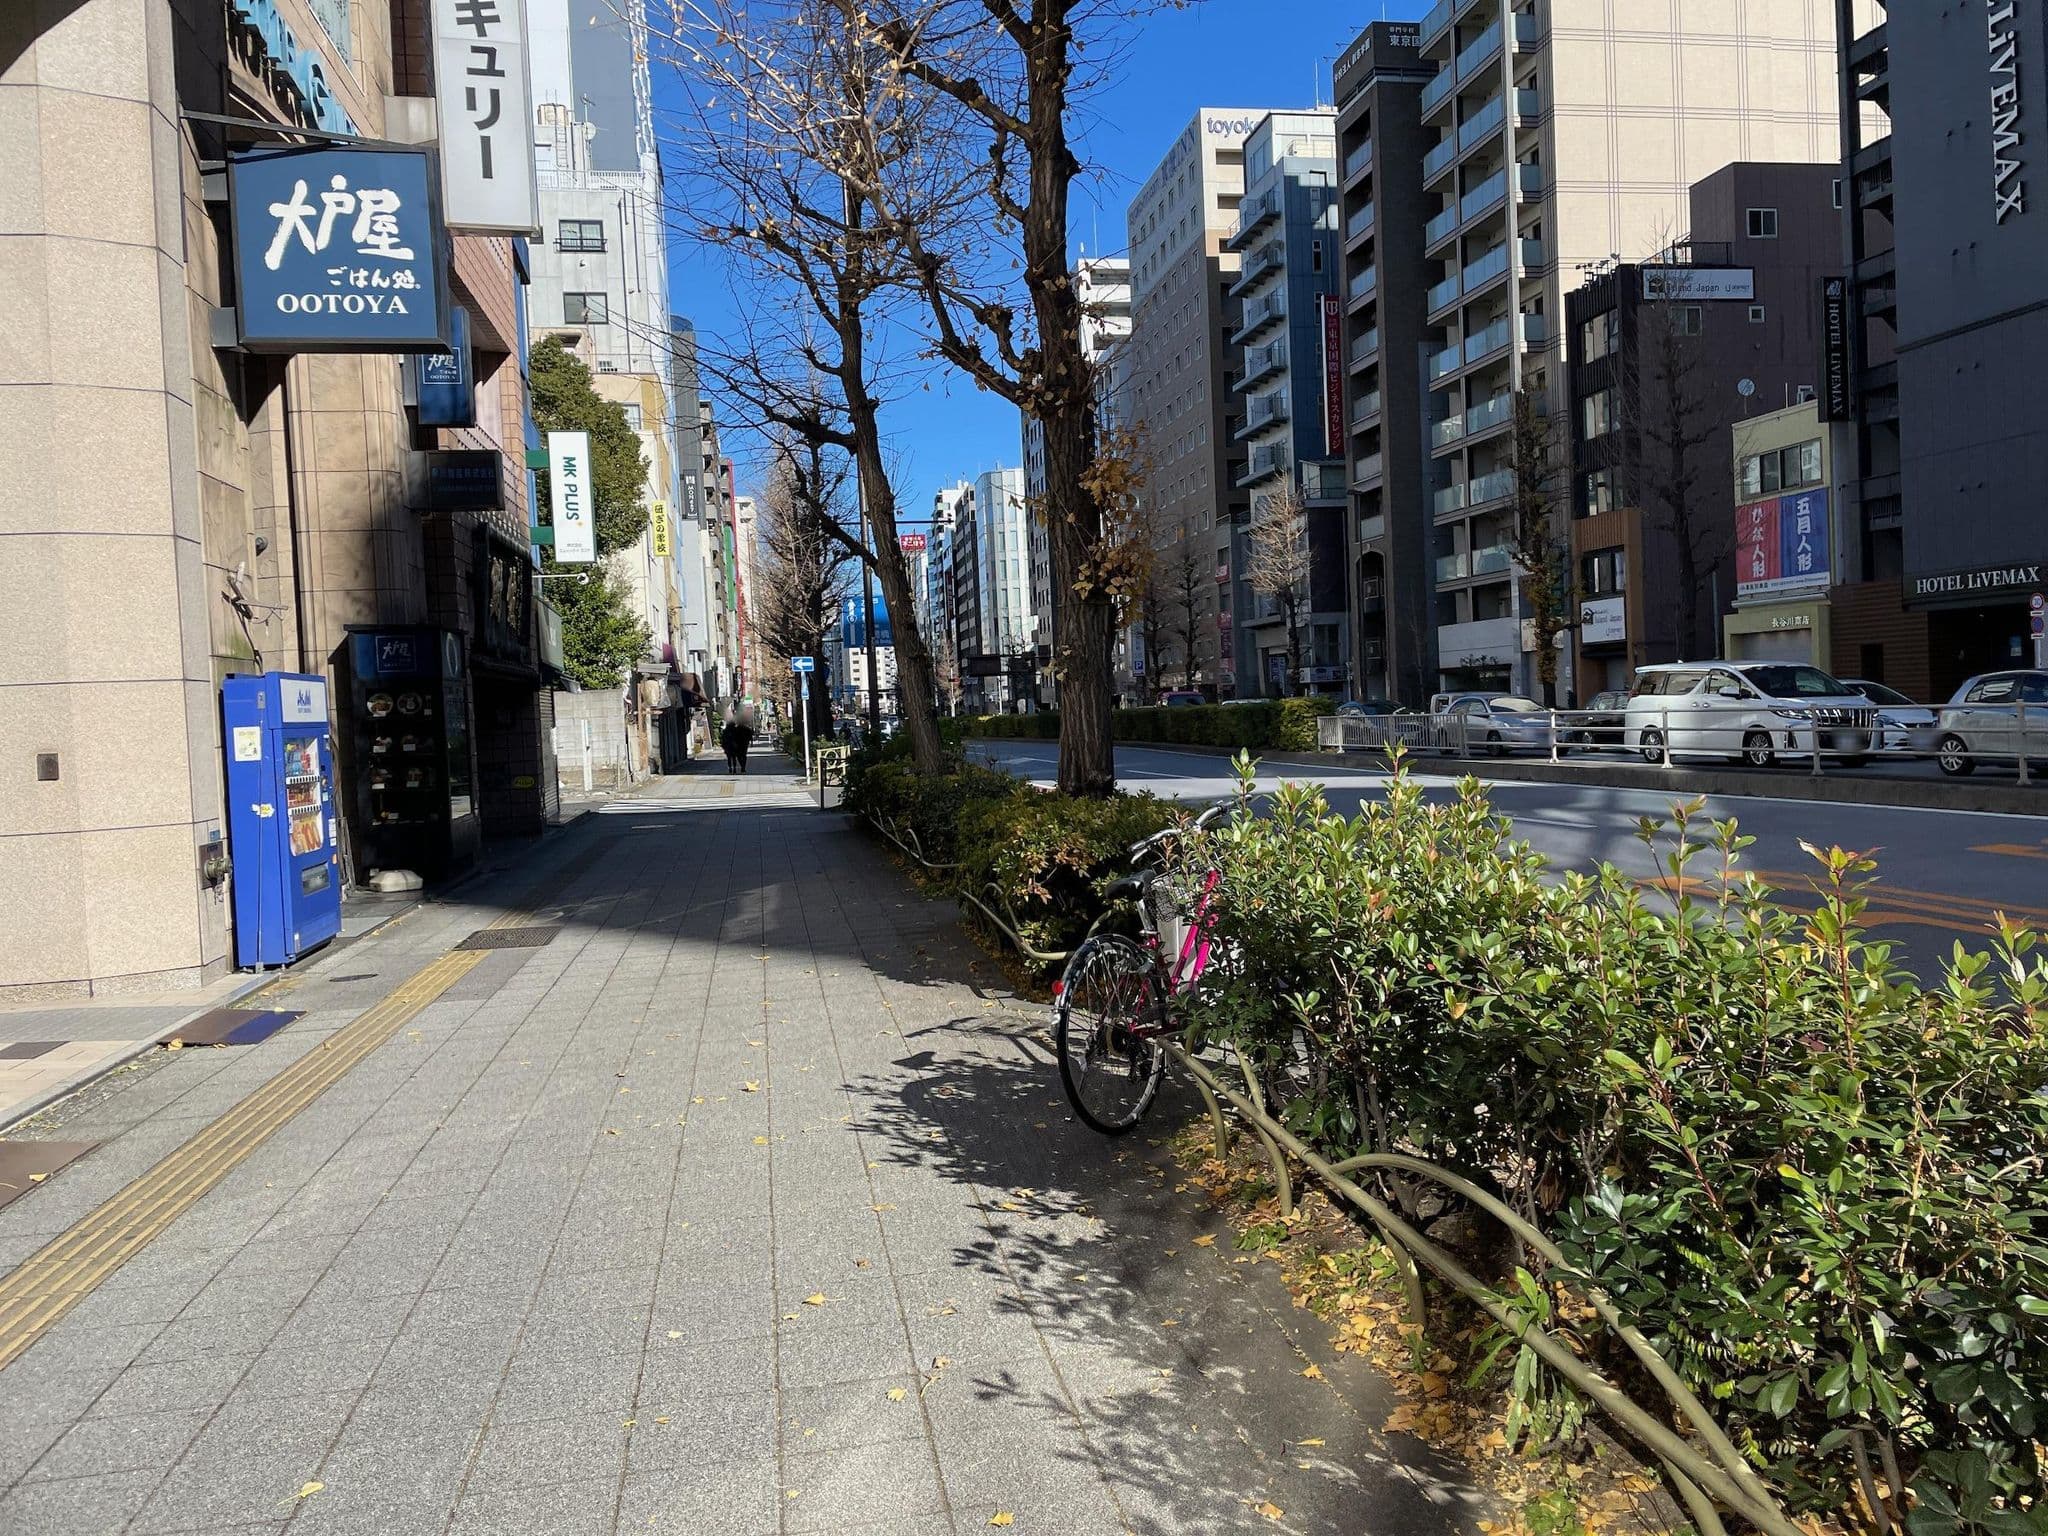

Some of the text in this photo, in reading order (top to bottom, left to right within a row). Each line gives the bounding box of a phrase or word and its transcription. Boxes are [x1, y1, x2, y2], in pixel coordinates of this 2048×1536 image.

[265, 175, 414, 270] 大戸屋
[277, 294, 408, 314] OOTOYA
[1696, 284, 1719, 293] Japan
[1829, 303, 1841, 348] HOTEL
[563, 456, 579, 520] MK PLUS
[1752, 507, 1765, 578] ひな人形
[1797, 497, 1812, 572] 五月人形
[1916, 575, 1964, 594] HOTEL
[1771, 615, 1810, 628] 長谷川商店
